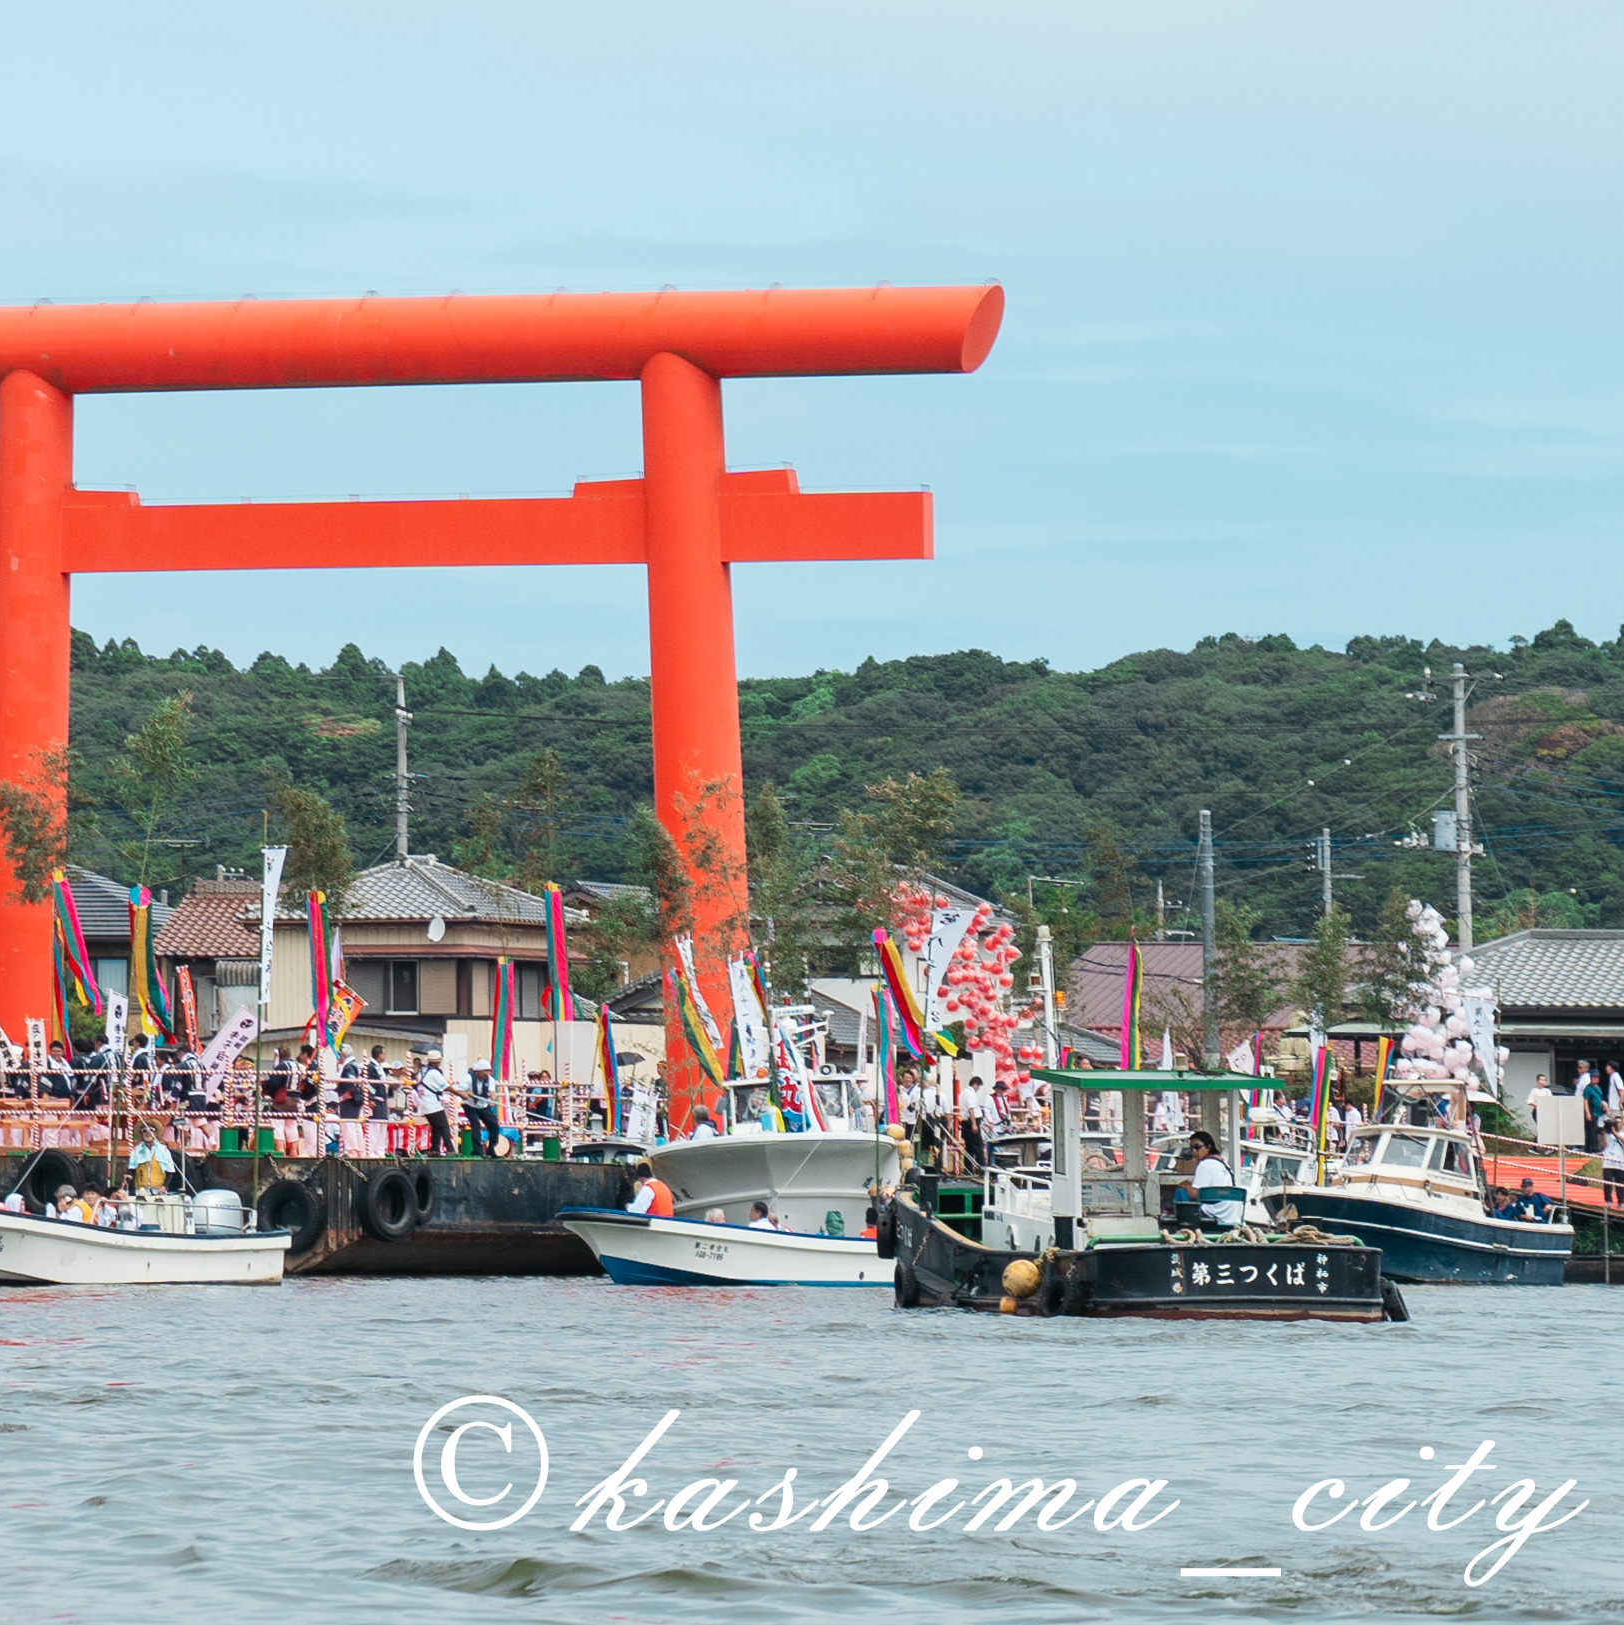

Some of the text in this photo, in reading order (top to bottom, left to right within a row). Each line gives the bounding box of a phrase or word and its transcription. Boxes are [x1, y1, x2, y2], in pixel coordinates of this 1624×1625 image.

[1192, 1261, 1306, 1286] 第三つくば
